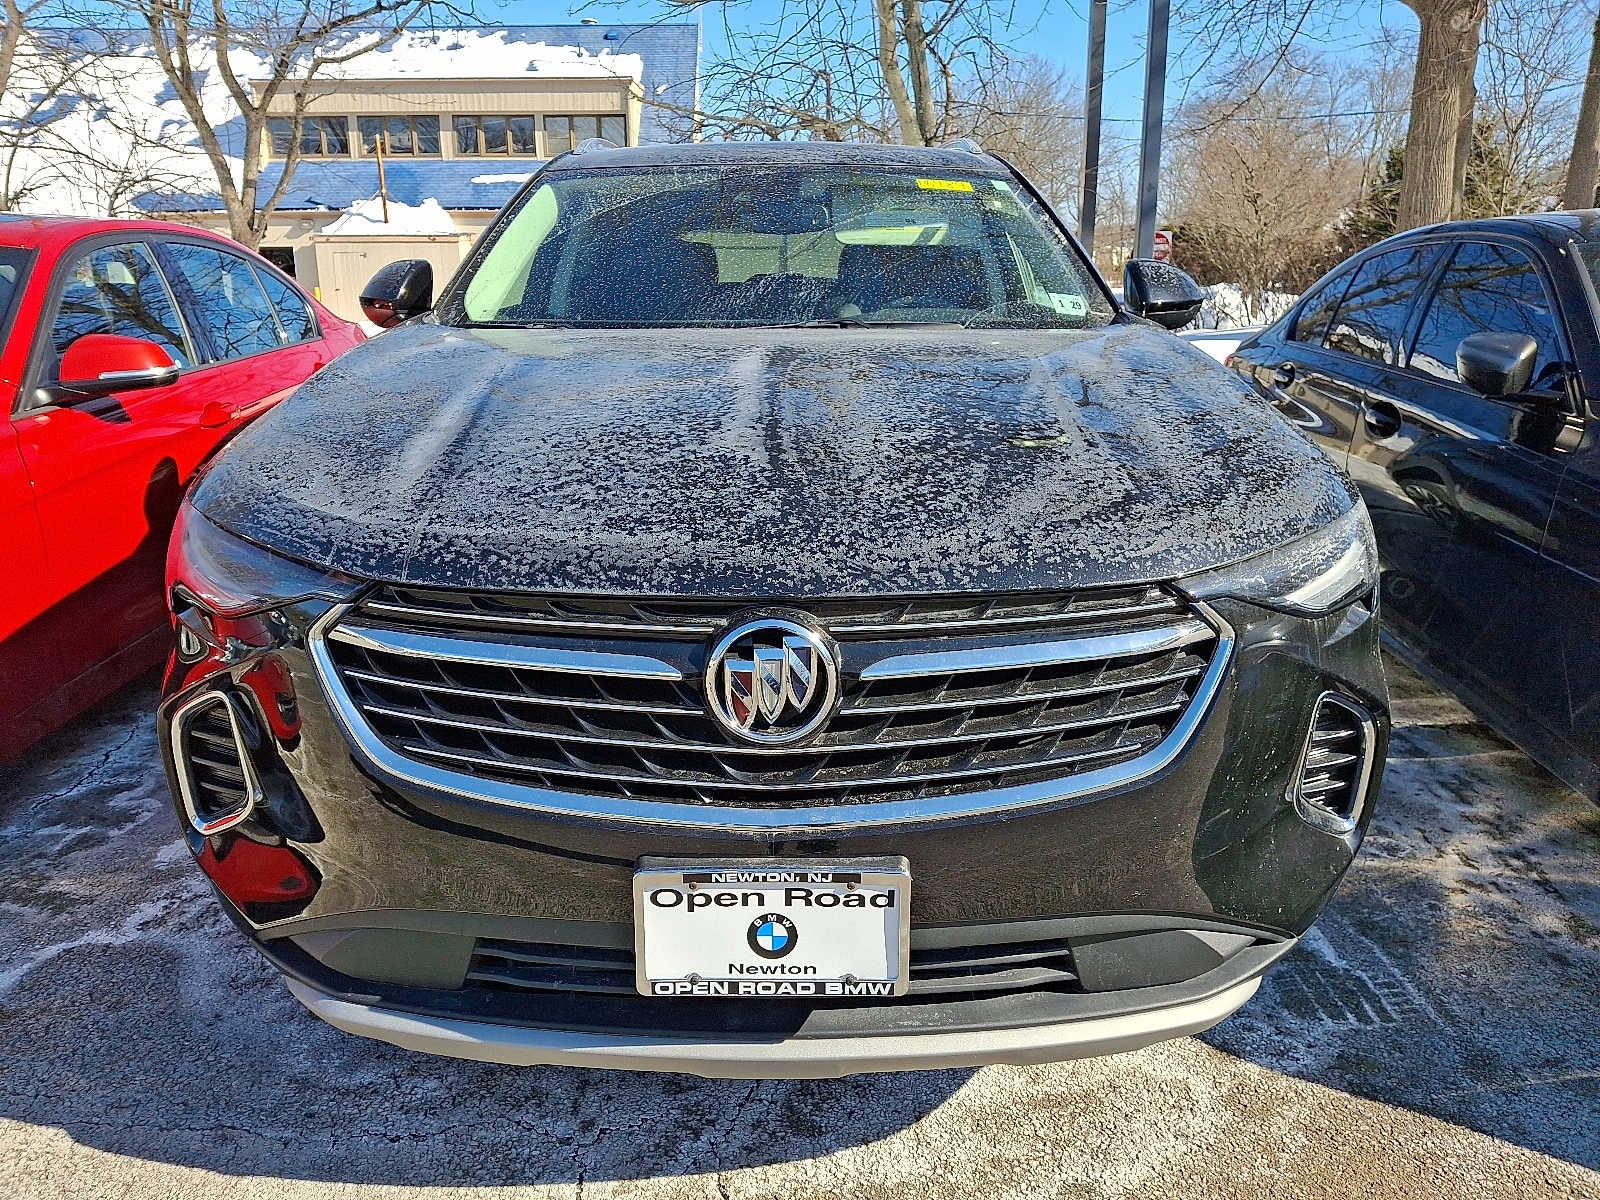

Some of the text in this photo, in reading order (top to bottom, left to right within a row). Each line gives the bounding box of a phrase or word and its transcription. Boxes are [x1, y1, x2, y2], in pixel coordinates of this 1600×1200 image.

[711, 872, 833, 884] NEWTON, NJ
[649, 888, 896, 912] Open Road
[753, 914, 793, 928] BMW
[728, 963, 817, 975] Newton
[654, 982, 892, 996] OPEN ROAD BMW
